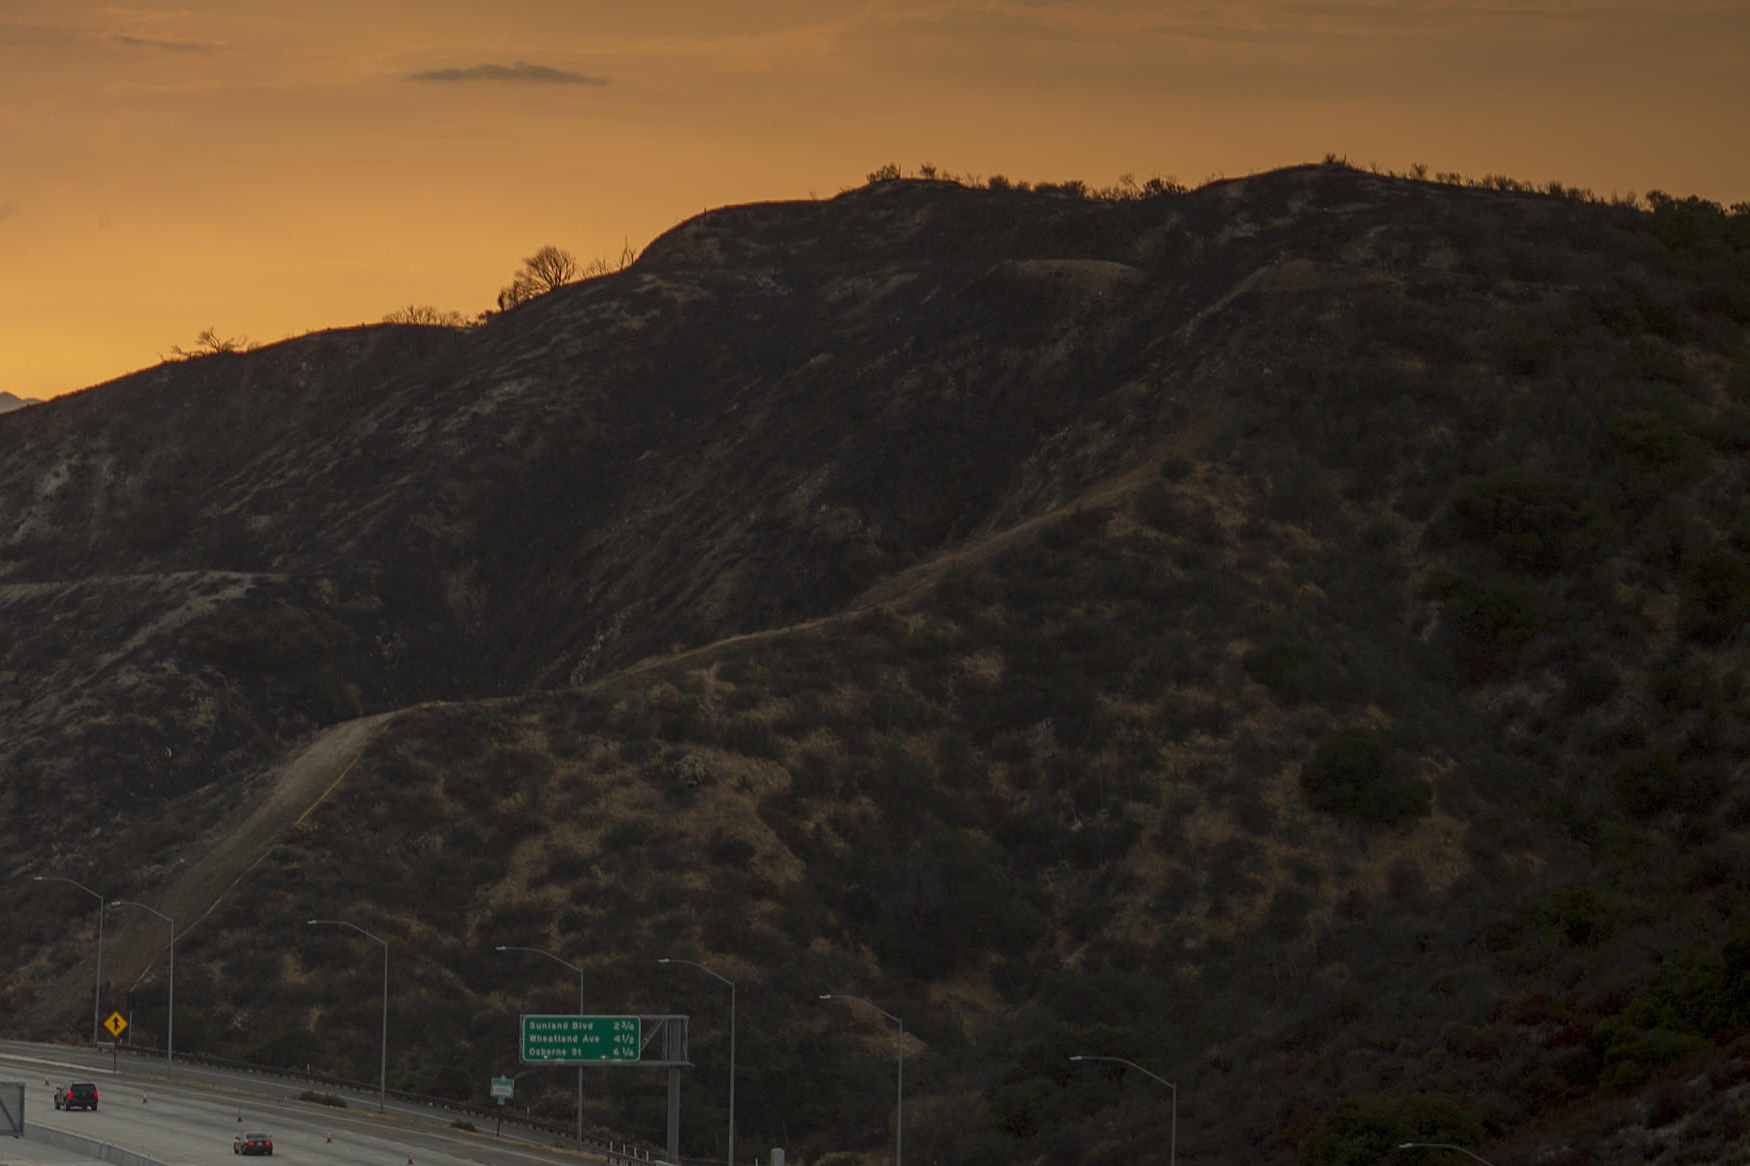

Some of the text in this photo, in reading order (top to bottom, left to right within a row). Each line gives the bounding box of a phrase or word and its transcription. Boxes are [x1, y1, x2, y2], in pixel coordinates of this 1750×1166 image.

[529, 1021, 568, 1030] Sunland
[572, 1021, 593, 1030] Blvd
[613, 1021, 620, 1030] 2
[529, 1034, 578, 1043] Wheatland
[582, 1034, 600, 1043] Ave
[529, 1047, 567, 1056] Osborne
[571, 1047, 582, 1056] St
[613, 1047, 620, 1056] 6
